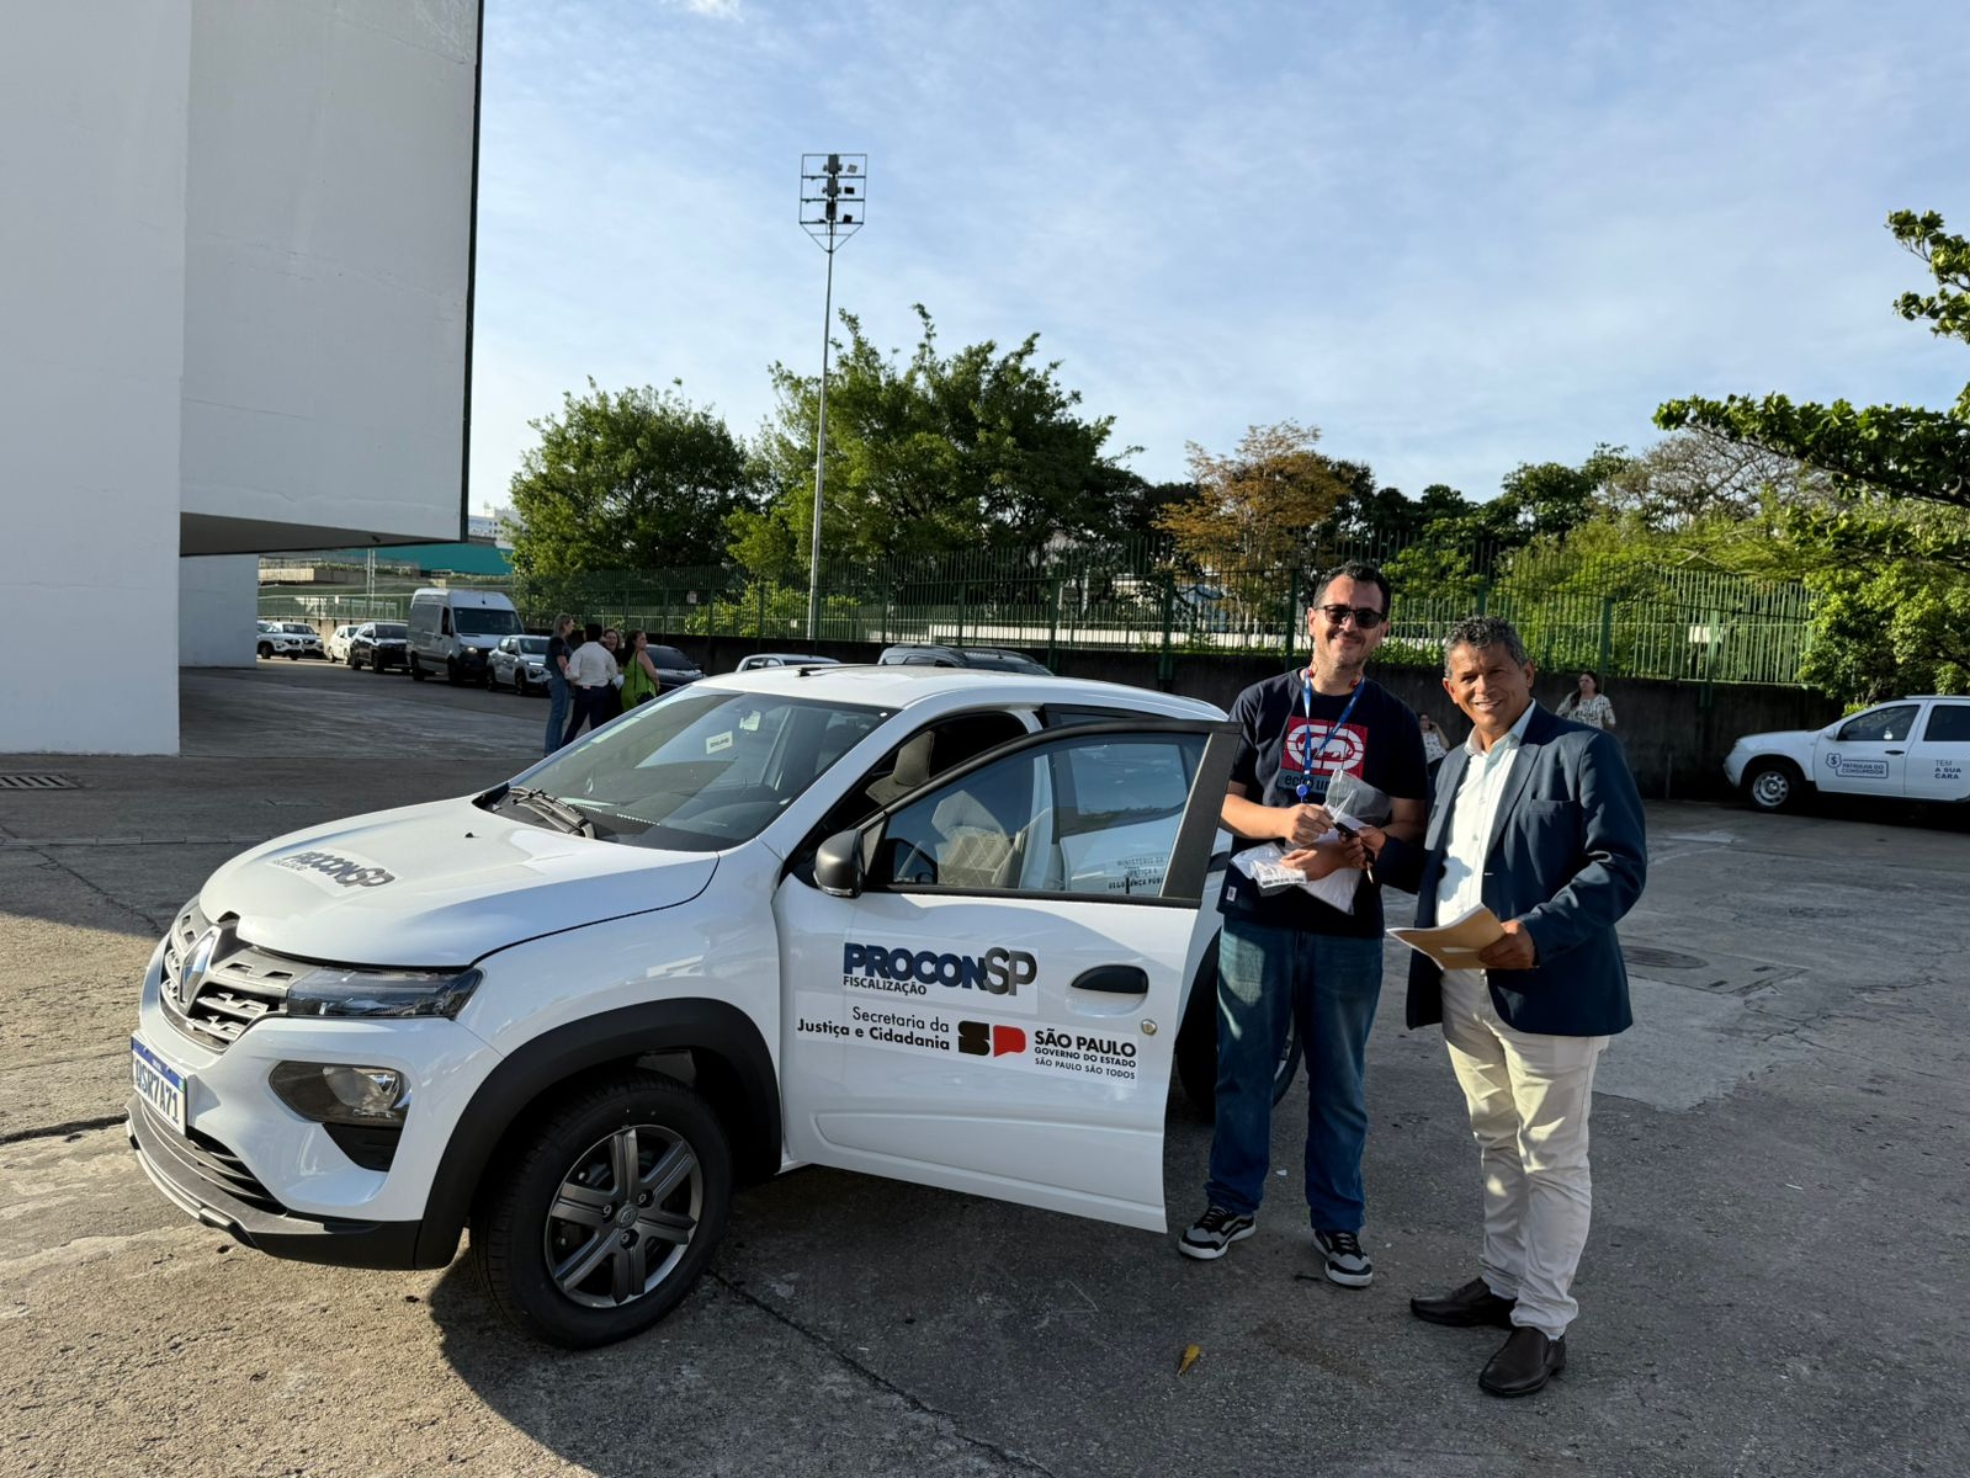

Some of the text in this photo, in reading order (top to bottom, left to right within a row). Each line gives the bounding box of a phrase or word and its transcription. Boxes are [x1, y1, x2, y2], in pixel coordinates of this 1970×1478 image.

[843, 942, 1037, 996] PROCONSP
[843, 976, 927, 996] FISCALIZAÇÃO
[852, 1006, 949, 1033] Secretaria da
[797, 1018, 950, 1050] Justiça e Cidadania
[1034, 1028, 1137, 1057] SÃO PAULO
[1034, 1046, 1137, 1068] GOVERNO DO ESTADO
[1034, 1057, 1136, 1080] SÃO PAULO SÃO TODOS
